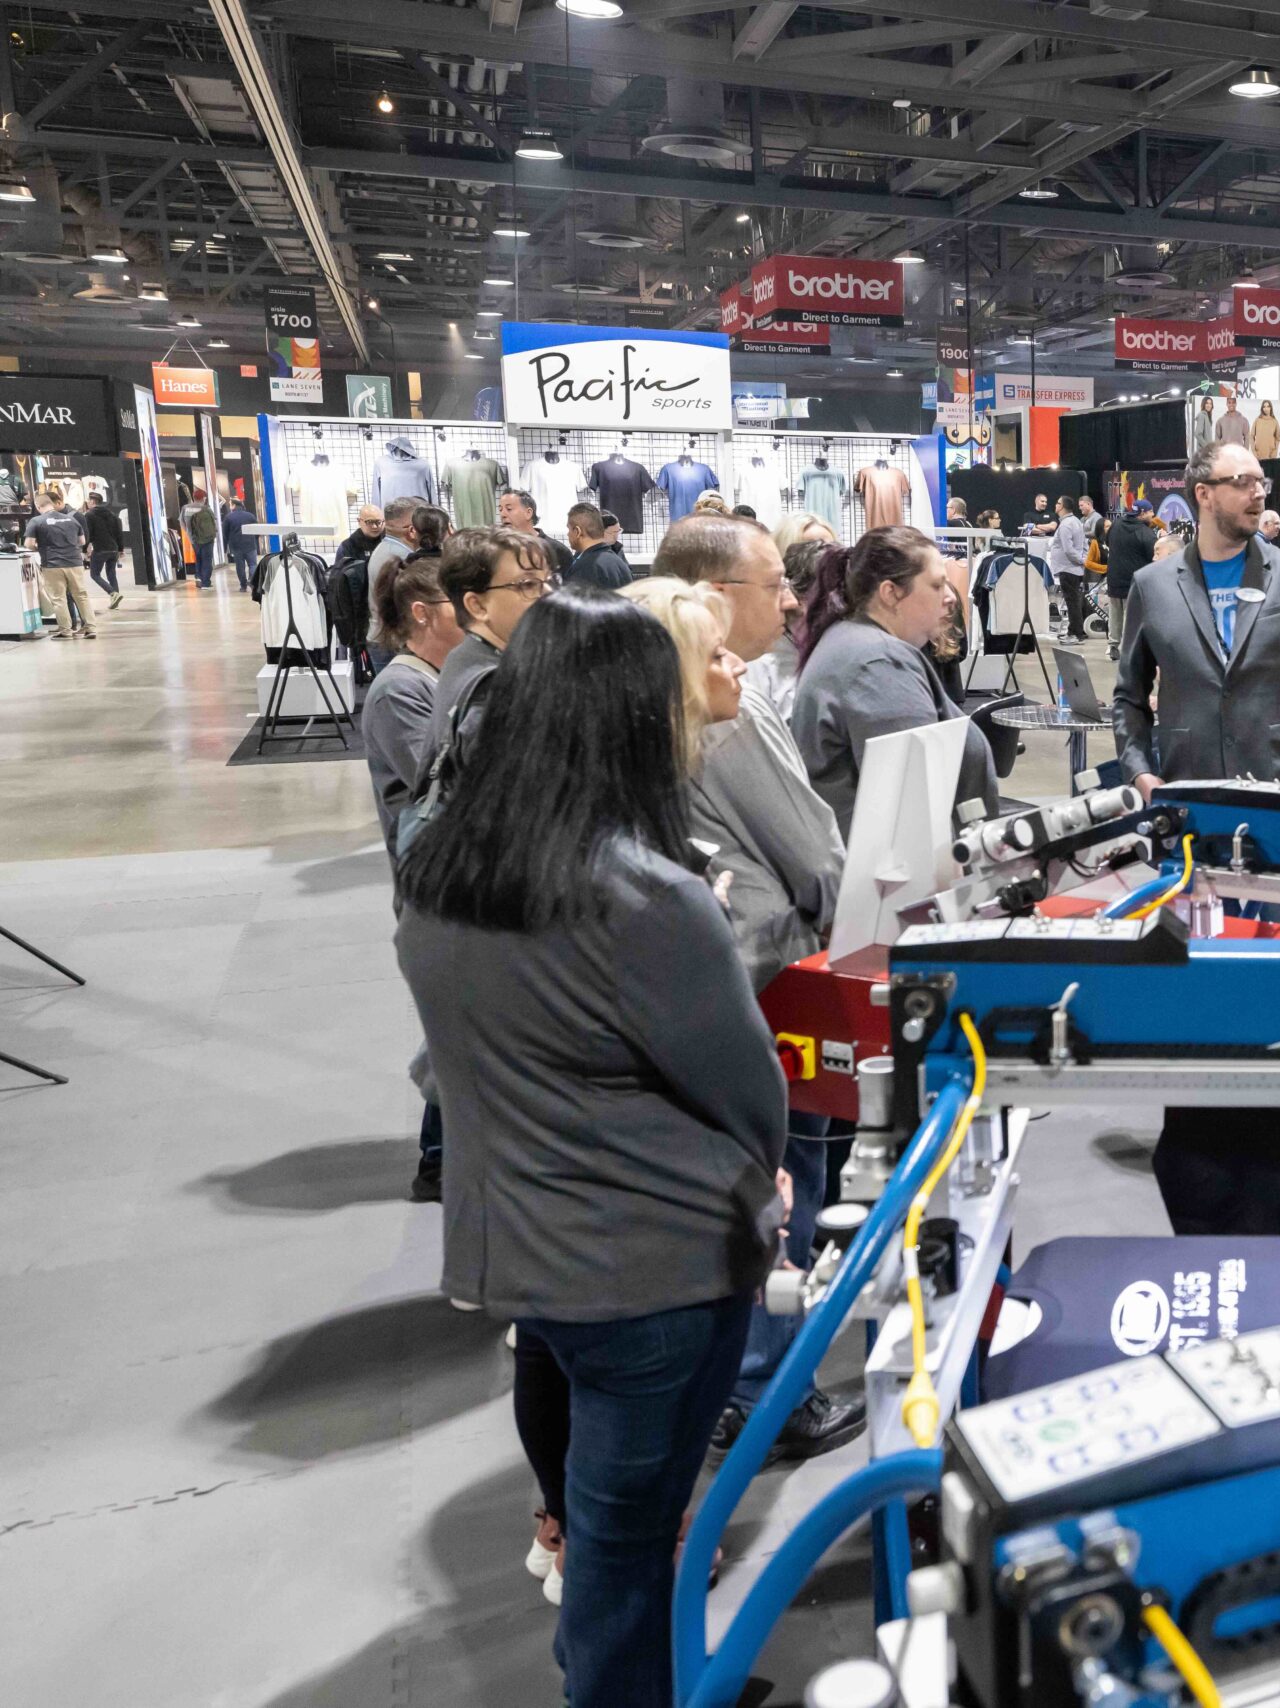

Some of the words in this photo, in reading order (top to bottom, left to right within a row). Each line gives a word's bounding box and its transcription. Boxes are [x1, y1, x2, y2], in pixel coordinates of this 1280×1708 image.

[753, 273, 775, 305] brother
[788, 270, 894, 300] brother
[271, 314, 312, 328] 1700
[802, 312, 829, 322] Direct
[831, 314, 840, 323] to
[842, 314, 881, 325] Garment
[1122, 328, 1196, 351] brother
[1207, 327, 1235, 351] broth
[744, 343, 767, 352] Direct
[768, 344, 777, 352] to
[778, 345, 811, 353] Garment
[940, 348, 970, 360] 1900
[1132, 361, 1151, 370] Direct
[1153, 362, 1160, 370] to
[1161, 362, 1188, 371] Garment
[161, 379, 208, 394] Hanes
[529, 345, 700, 420] Pacific
[1017, 389, 1053, 400] TRASFER
[1054, 391, 1086, 401] EXPRESS
[651, 398, 712, 410] sports
[0, 402, 76, 425] NMAR
